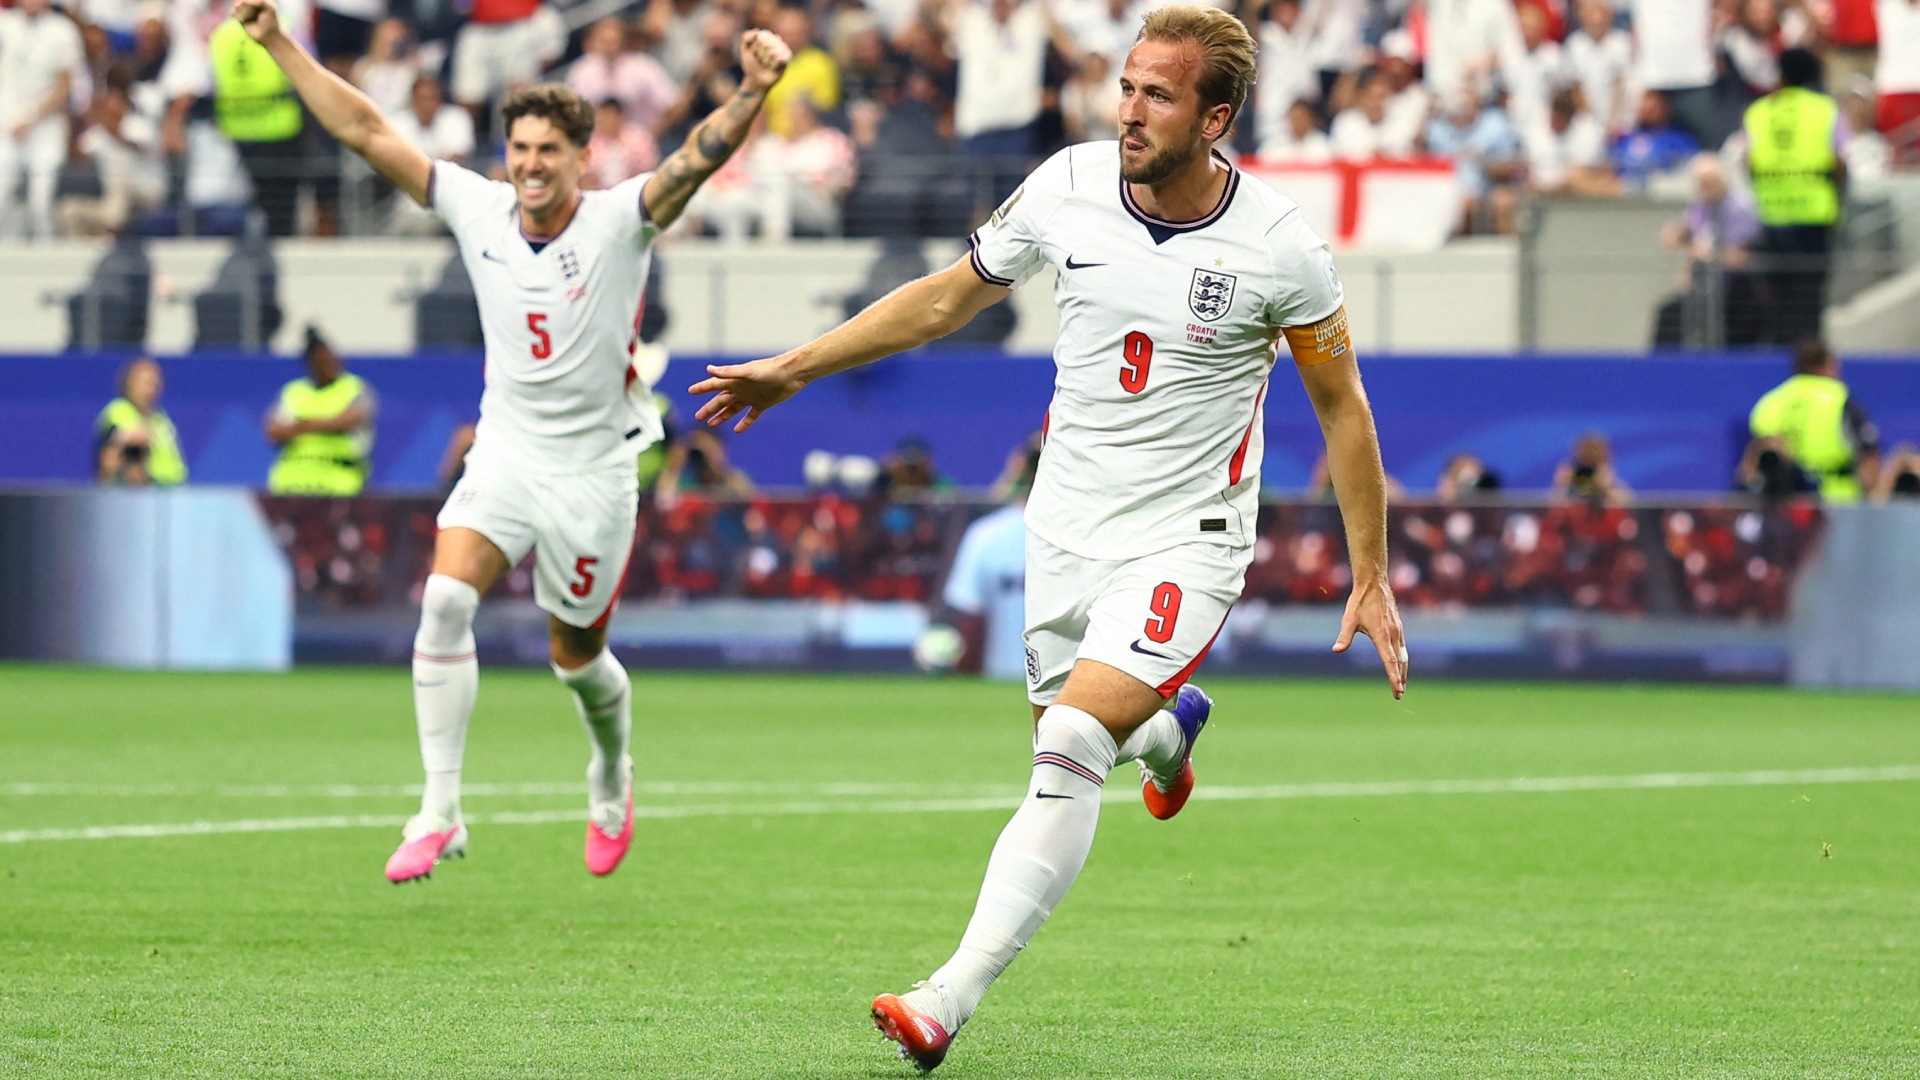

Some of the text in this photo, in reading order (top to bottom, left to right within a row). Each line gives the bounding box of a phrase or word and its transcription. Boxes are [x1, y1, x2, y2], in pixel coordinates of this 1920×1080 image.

[527, 312, 552, 360] 5
[1186, 323, 1217, 336] CROATIA
[1315, 316, 1347, 343] UNITES
[1120, 331, 1153, 394] 9
[1332, 345, 1345, 356] FIFA
[571, 556, 599, 597] 5
[1144, 581, 1182, 644] 9
